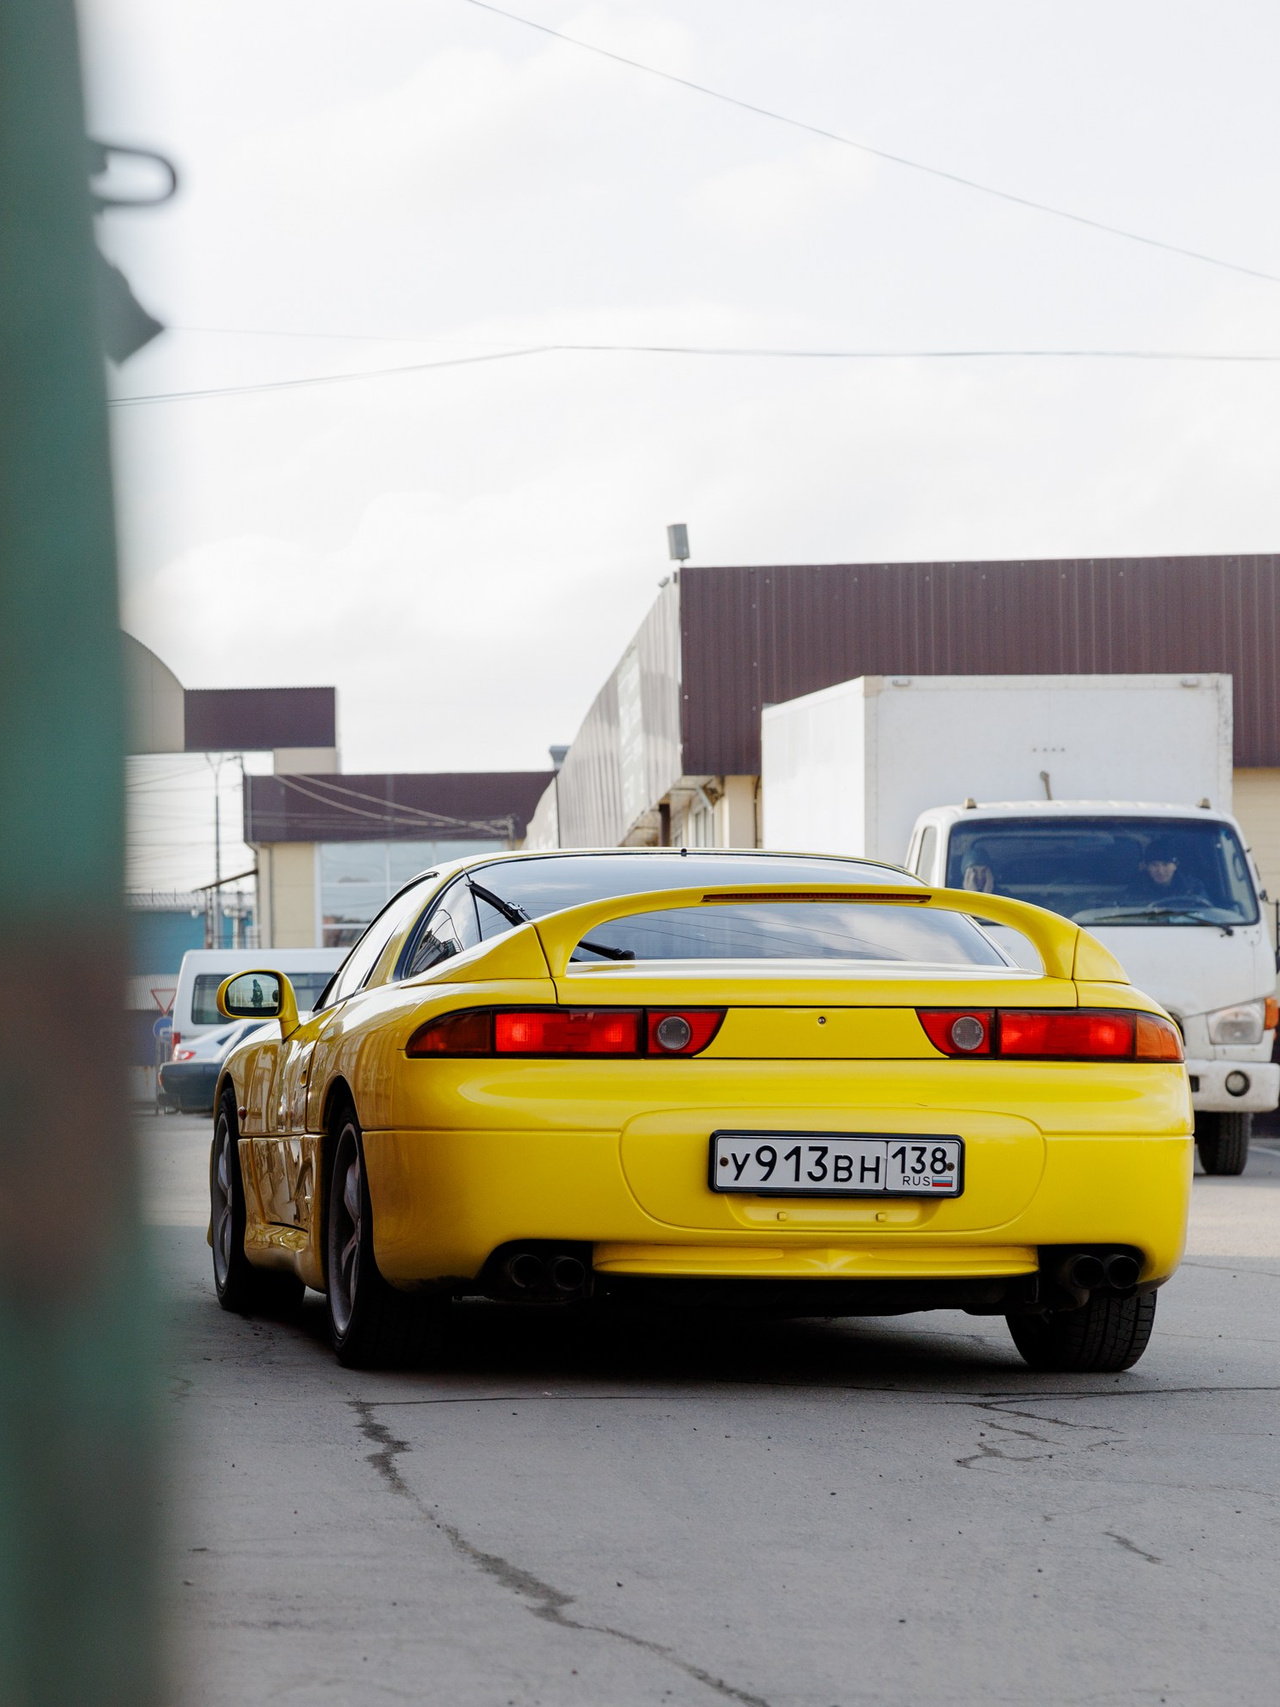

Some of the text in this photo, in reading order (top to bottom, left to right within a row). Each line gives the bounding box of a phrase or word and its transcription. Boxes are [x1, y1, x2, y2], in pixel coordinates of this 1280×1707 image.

[731, 1145, 948, 1184] У913ВН 138
[902, 1175, 931, 1187] RUS
